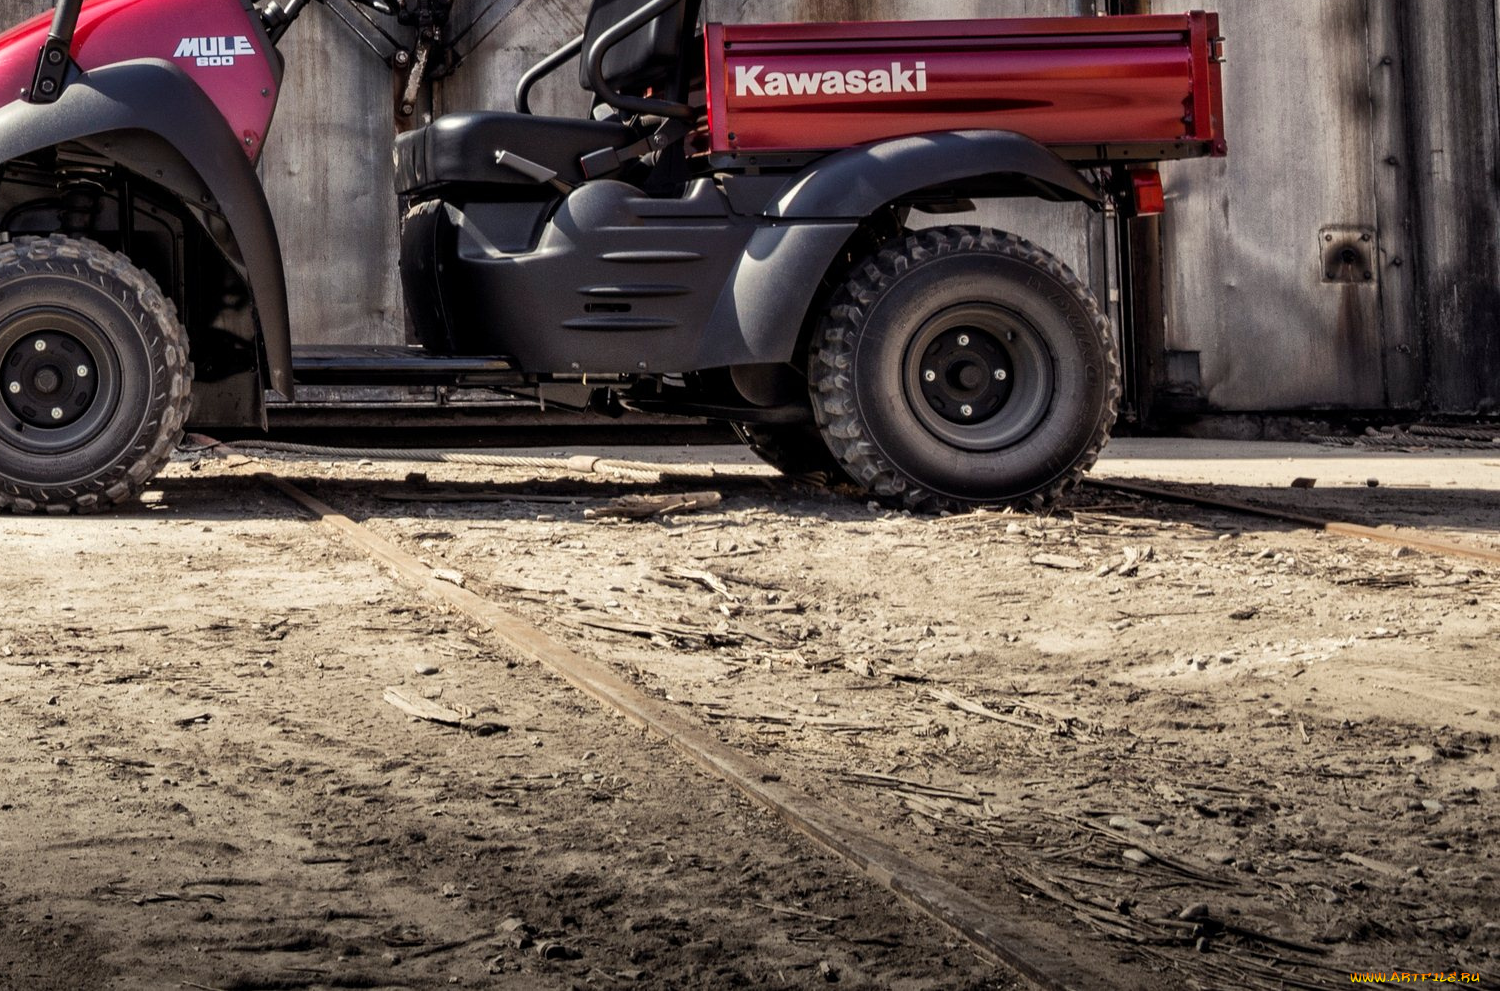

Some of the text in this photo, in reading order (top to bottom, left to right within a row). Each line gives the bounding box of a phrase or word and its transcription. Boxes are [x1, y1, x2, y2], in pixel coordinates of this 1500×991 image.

[173, 35, 256, 57] MULE
[196, 56, 234, 67] 600
[735, 61, 927, 96] Kawasaki
